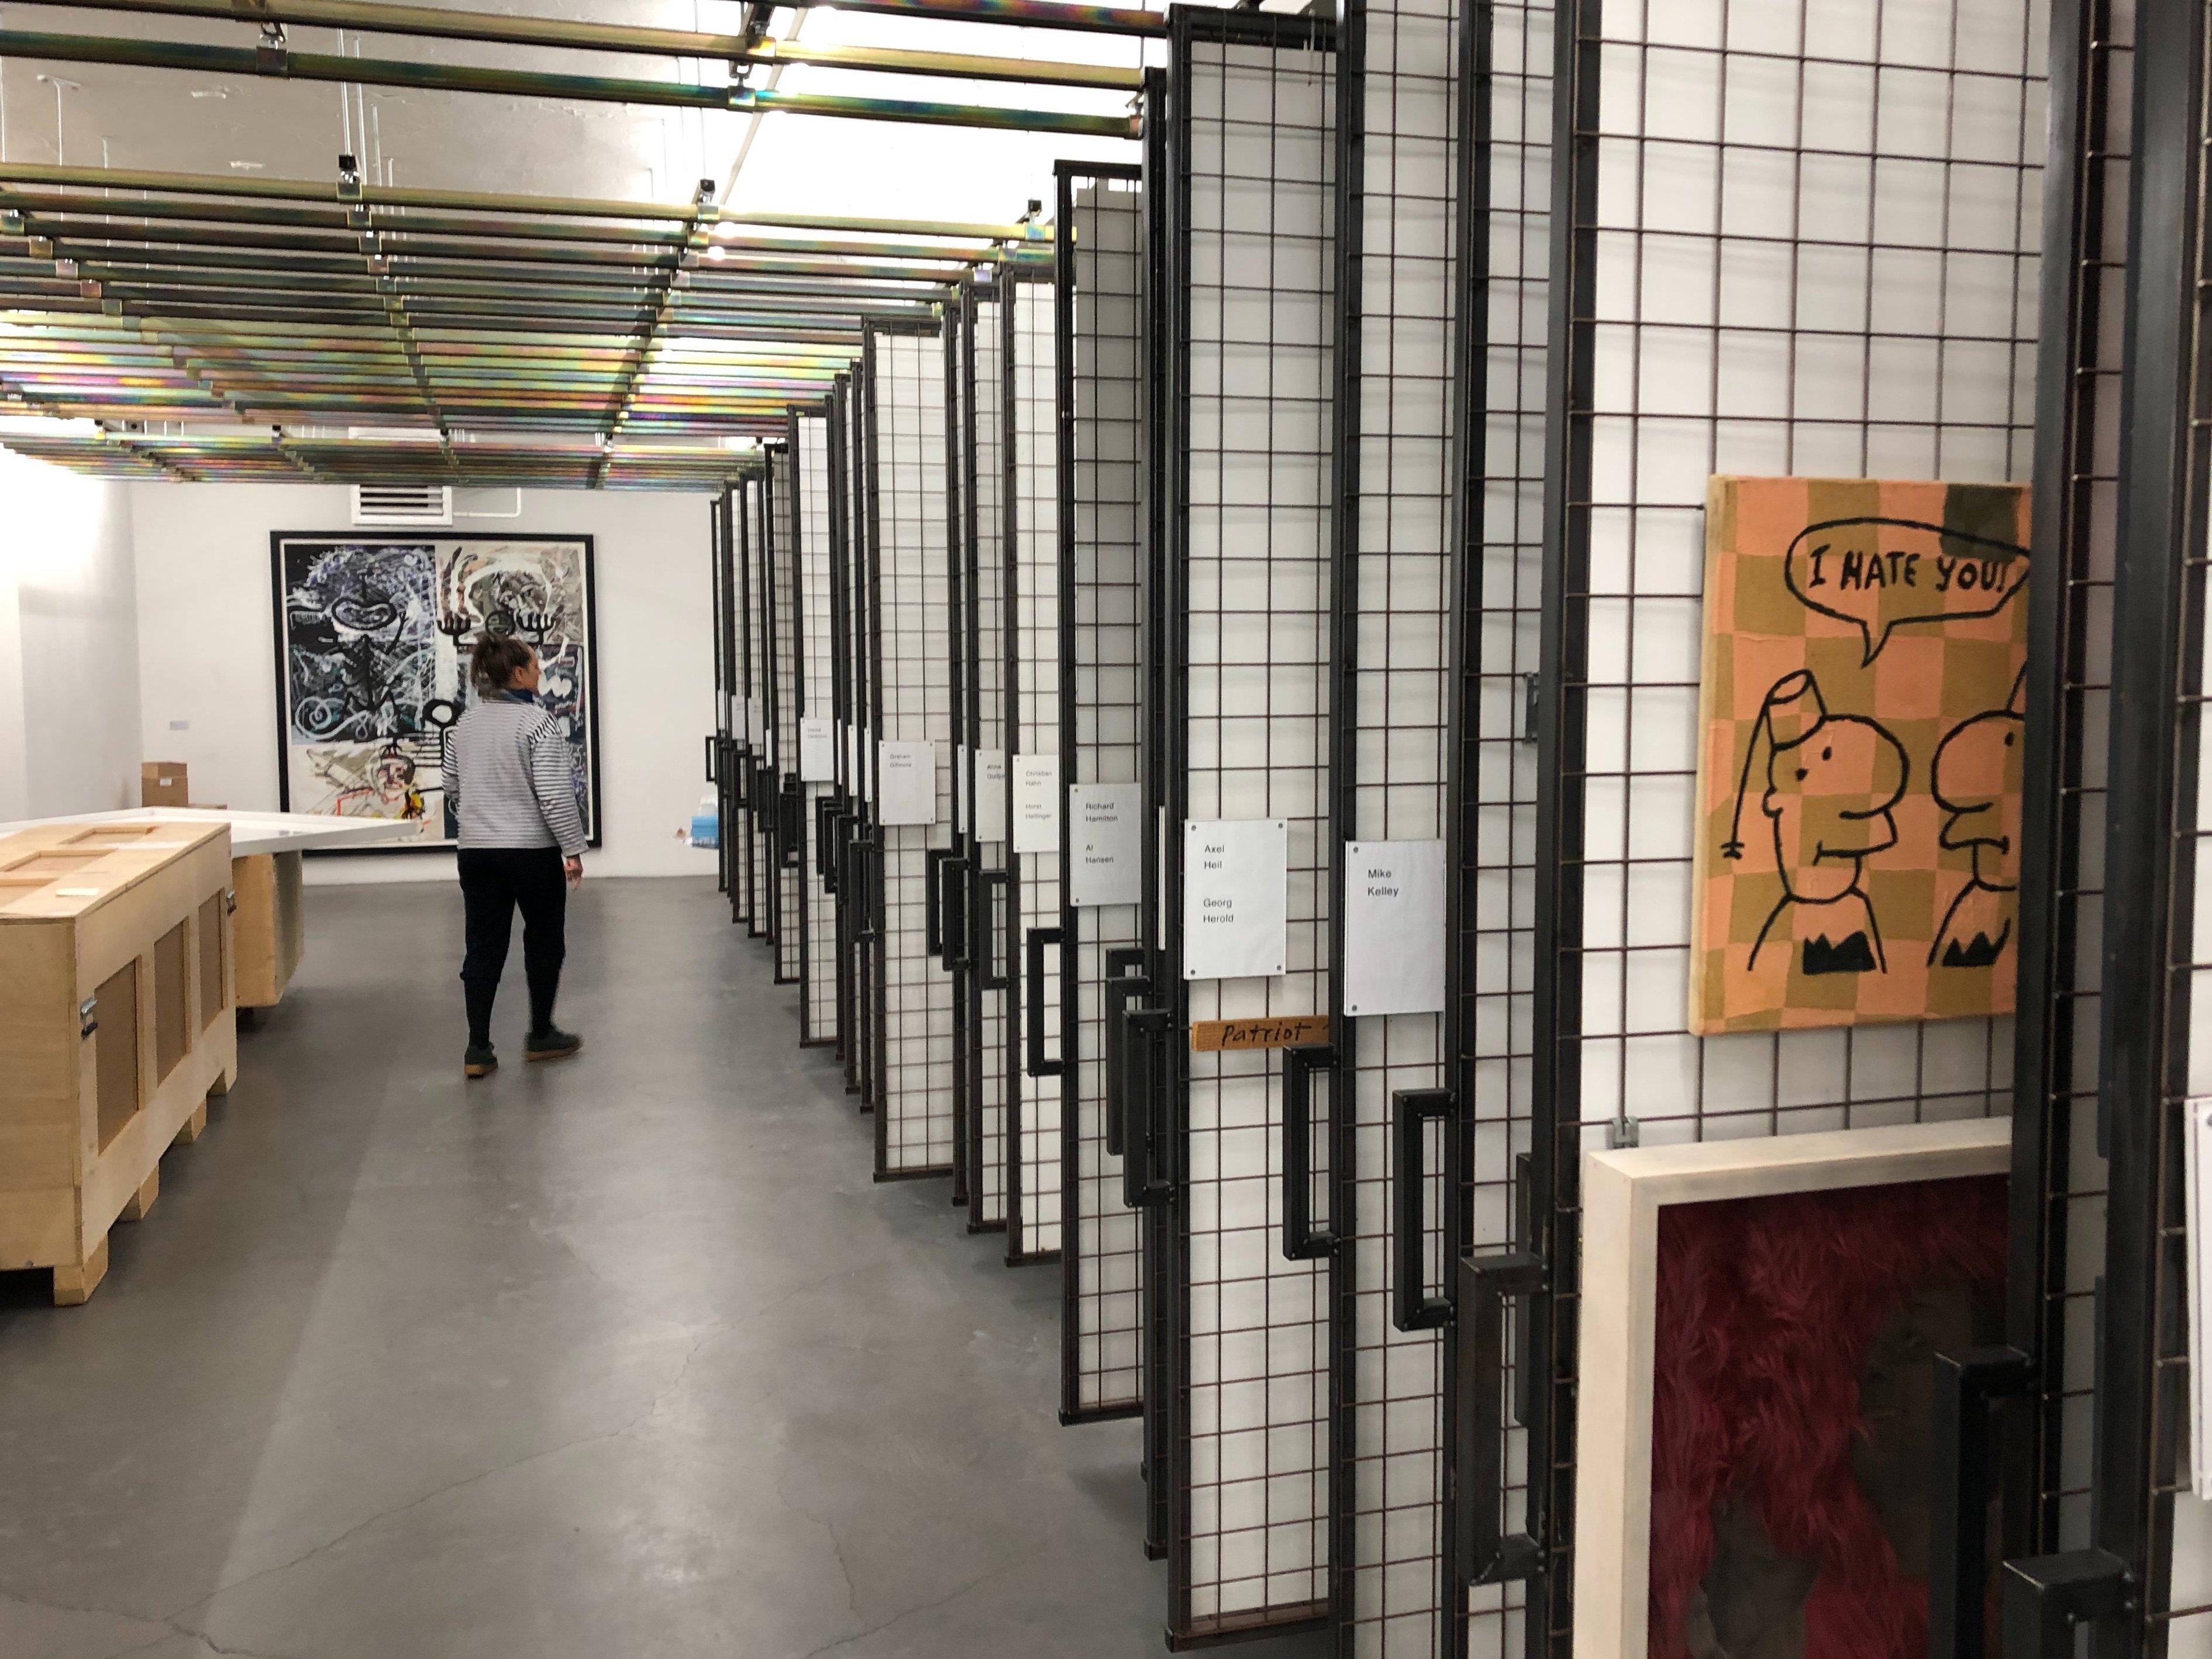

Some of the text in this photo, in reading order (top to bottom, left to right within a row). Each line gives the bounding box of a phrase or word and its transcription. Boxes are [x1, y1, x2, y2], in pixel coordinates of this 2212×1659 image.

[1810, 543, 2010, 593] I HATE YOU!
[1086, 802, 1114, 810] Richard
[1204, 845, 1225, 853] Axel
[1204, 860, 1222, 869] Heil
[1367, 869, 1392, 879] Mike
[1367, 886, 1399, 897] Kelley
[1203, 897, 1232, 909] Georg
[1203, 914, 1234, 923] Herold
[1222, 1021, 1312, 1047] Patriot
